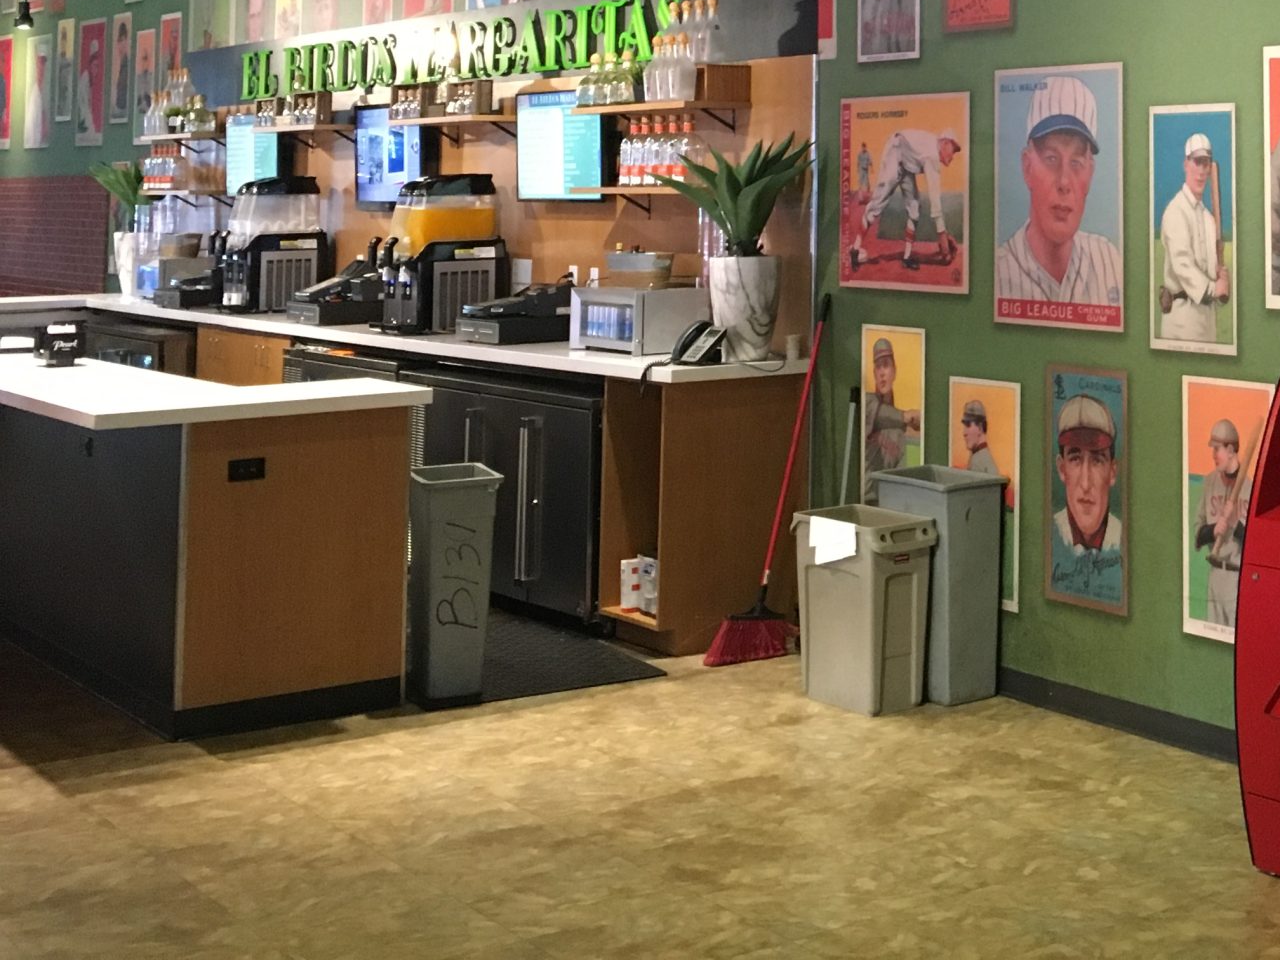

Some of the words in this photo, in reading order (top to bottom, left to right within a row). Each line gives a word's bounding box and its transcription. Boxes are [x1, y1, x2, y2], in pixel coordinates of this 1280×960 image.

[240, 49, 279, 100] EL
[283, 34, 397, 94] BIRDOS
[1001, 302, 1021, 315] BIG
[1026, 303, 1073, 320] LEAGUE
[436, 522, 482, 629] B131
